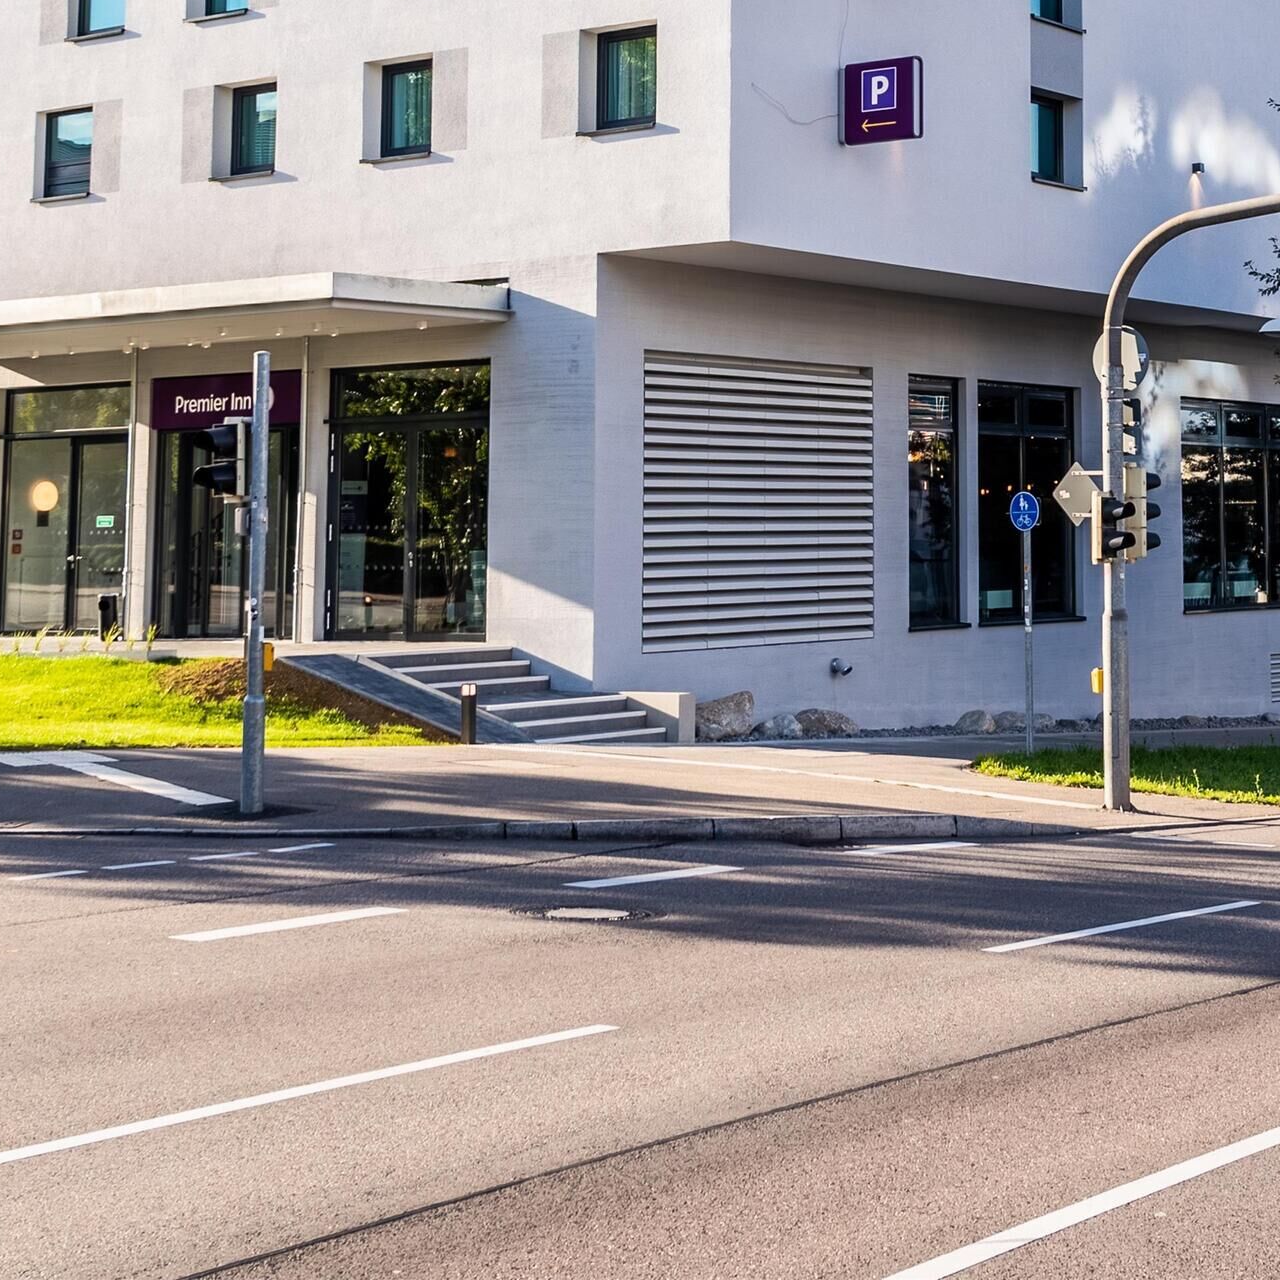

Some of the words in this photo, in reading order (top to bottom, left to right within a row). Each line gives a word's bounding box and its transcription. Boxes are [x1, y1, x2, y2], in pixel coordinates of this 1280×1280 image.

[871, 75, 890, 105] P
[174, 393, 229, 414] Premier
[231, 392, 252, 411] Inn
